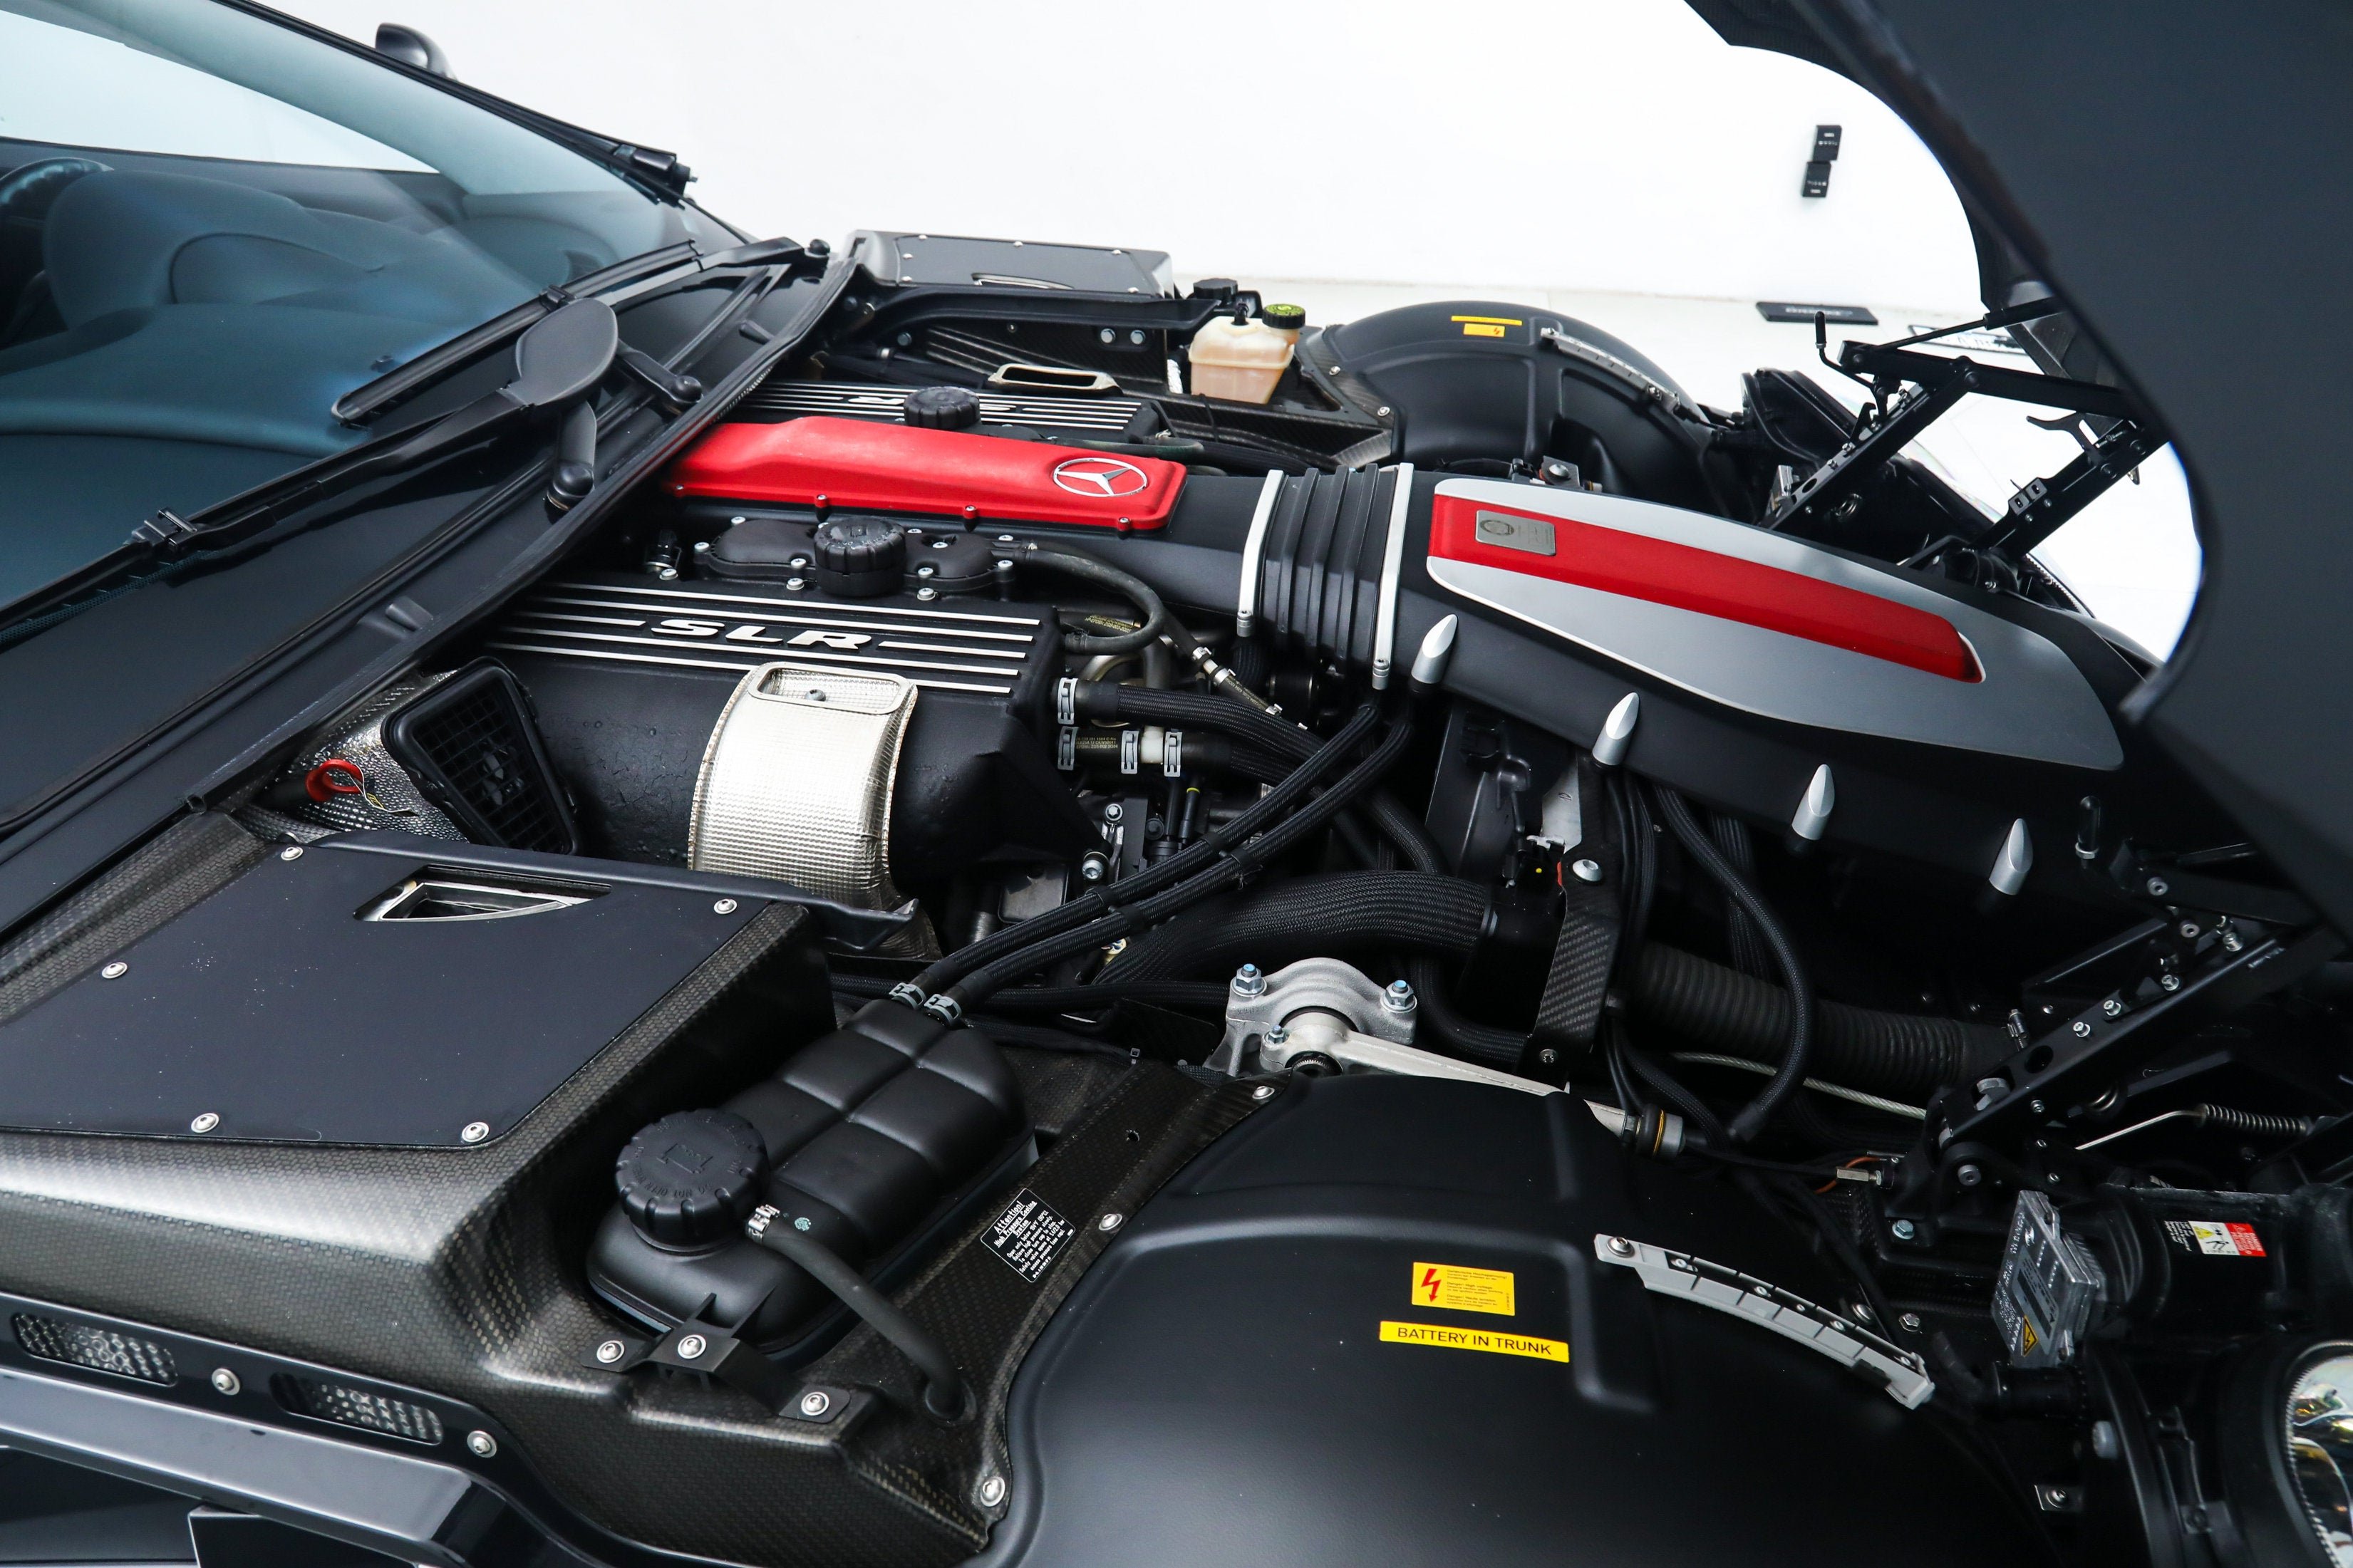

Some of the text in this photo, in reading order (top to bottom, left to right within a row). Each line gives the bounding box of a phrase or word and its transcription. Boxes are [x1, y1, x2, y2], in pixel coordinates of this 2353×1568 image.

[651, 619, 872, 650] SLR
[993, 1201, 1035, 1247] High Pressure Cooling
[994, 1200, 1023, 1234] Attention!
[1012, 1217, 1029, 1236] System
[1397, 1327, 1552, 1355] BATTERY IN TRUNK
